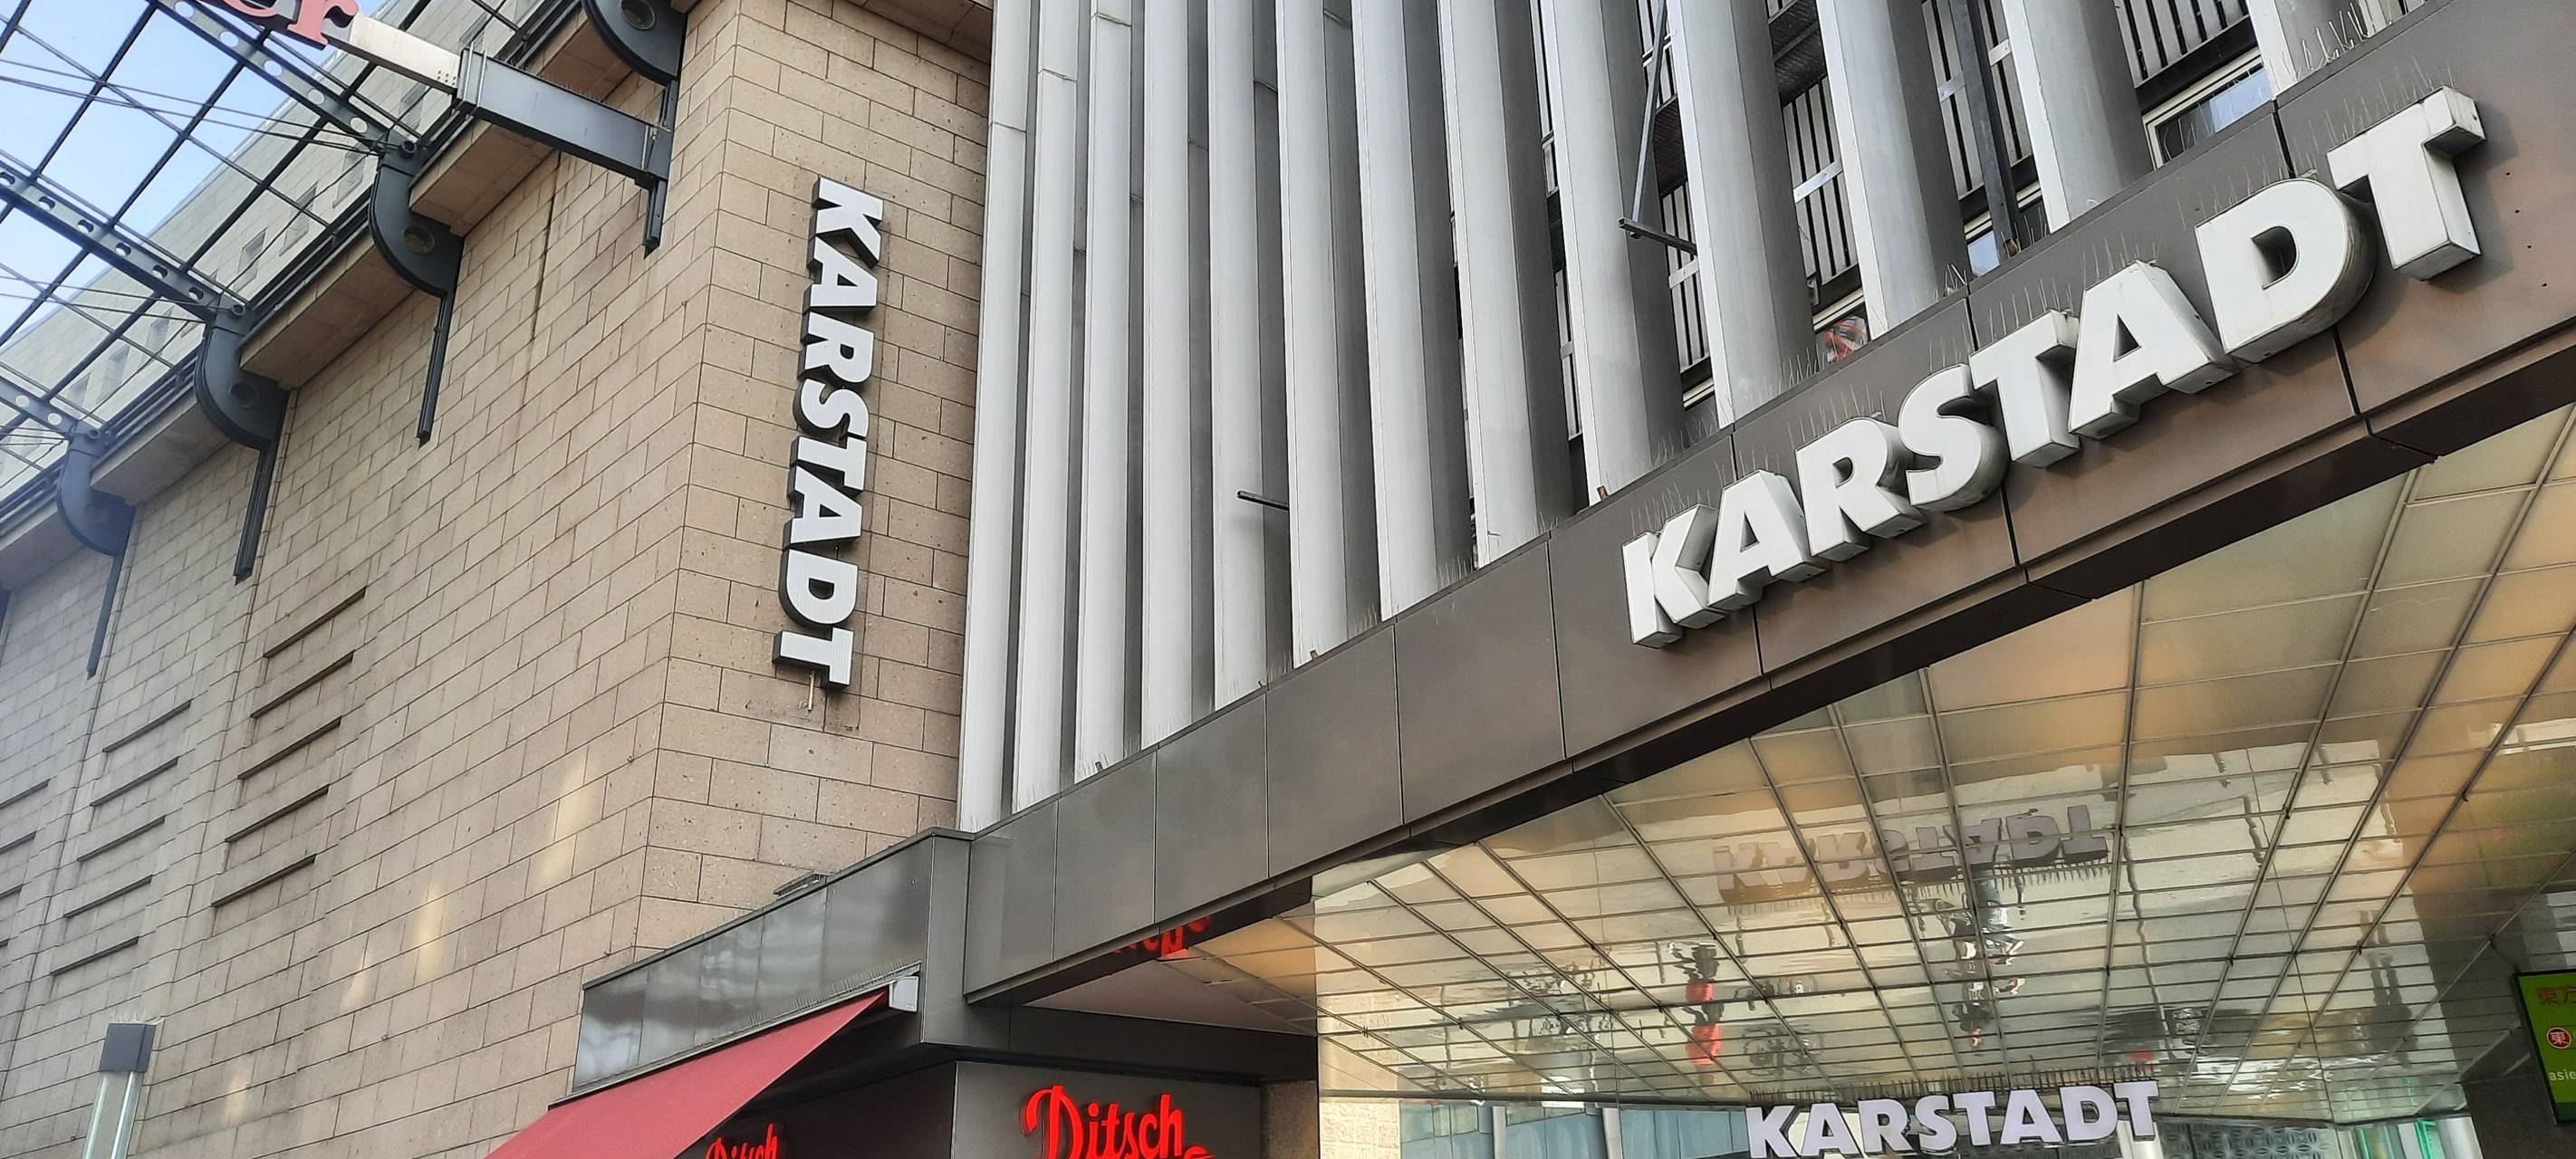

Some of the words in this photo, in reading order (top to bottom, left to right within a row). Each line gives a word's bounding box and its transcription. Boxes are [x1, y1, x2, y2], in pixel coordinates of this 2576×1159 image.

[774, 177, 884, 690] KARSTADT
[1622, 86, 2485, 648] KARSTADT
[1024, 1085, 1183, 1159] Ditsch
[1745, 1080, 2161, 1159] KARSTADT
